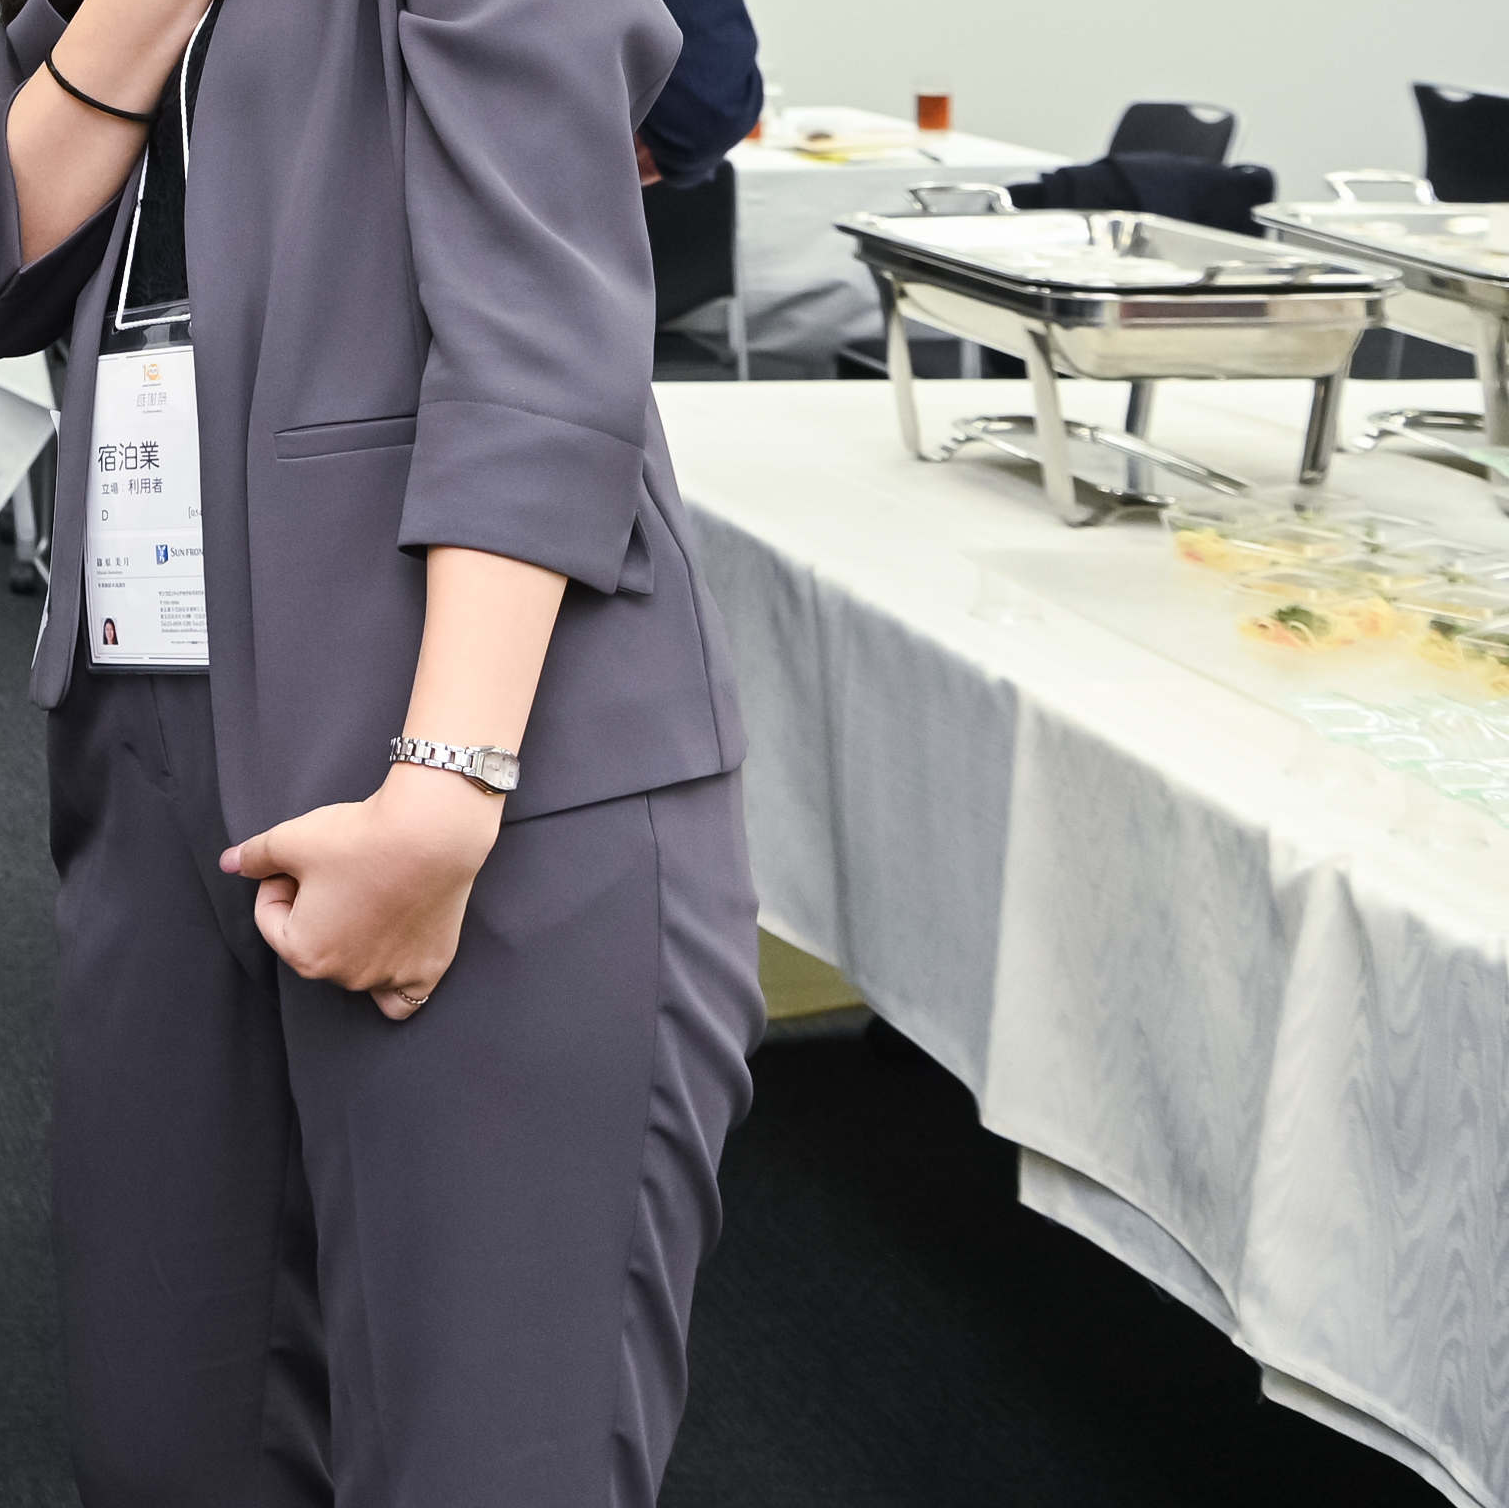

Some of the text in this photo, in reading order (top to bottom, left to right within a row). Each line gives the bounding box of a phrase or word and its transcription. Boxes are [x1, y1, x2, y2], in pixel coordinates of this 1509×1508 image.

[98, 440, 160, 472] 宿泊業
[101, 509, 109, 522] D
